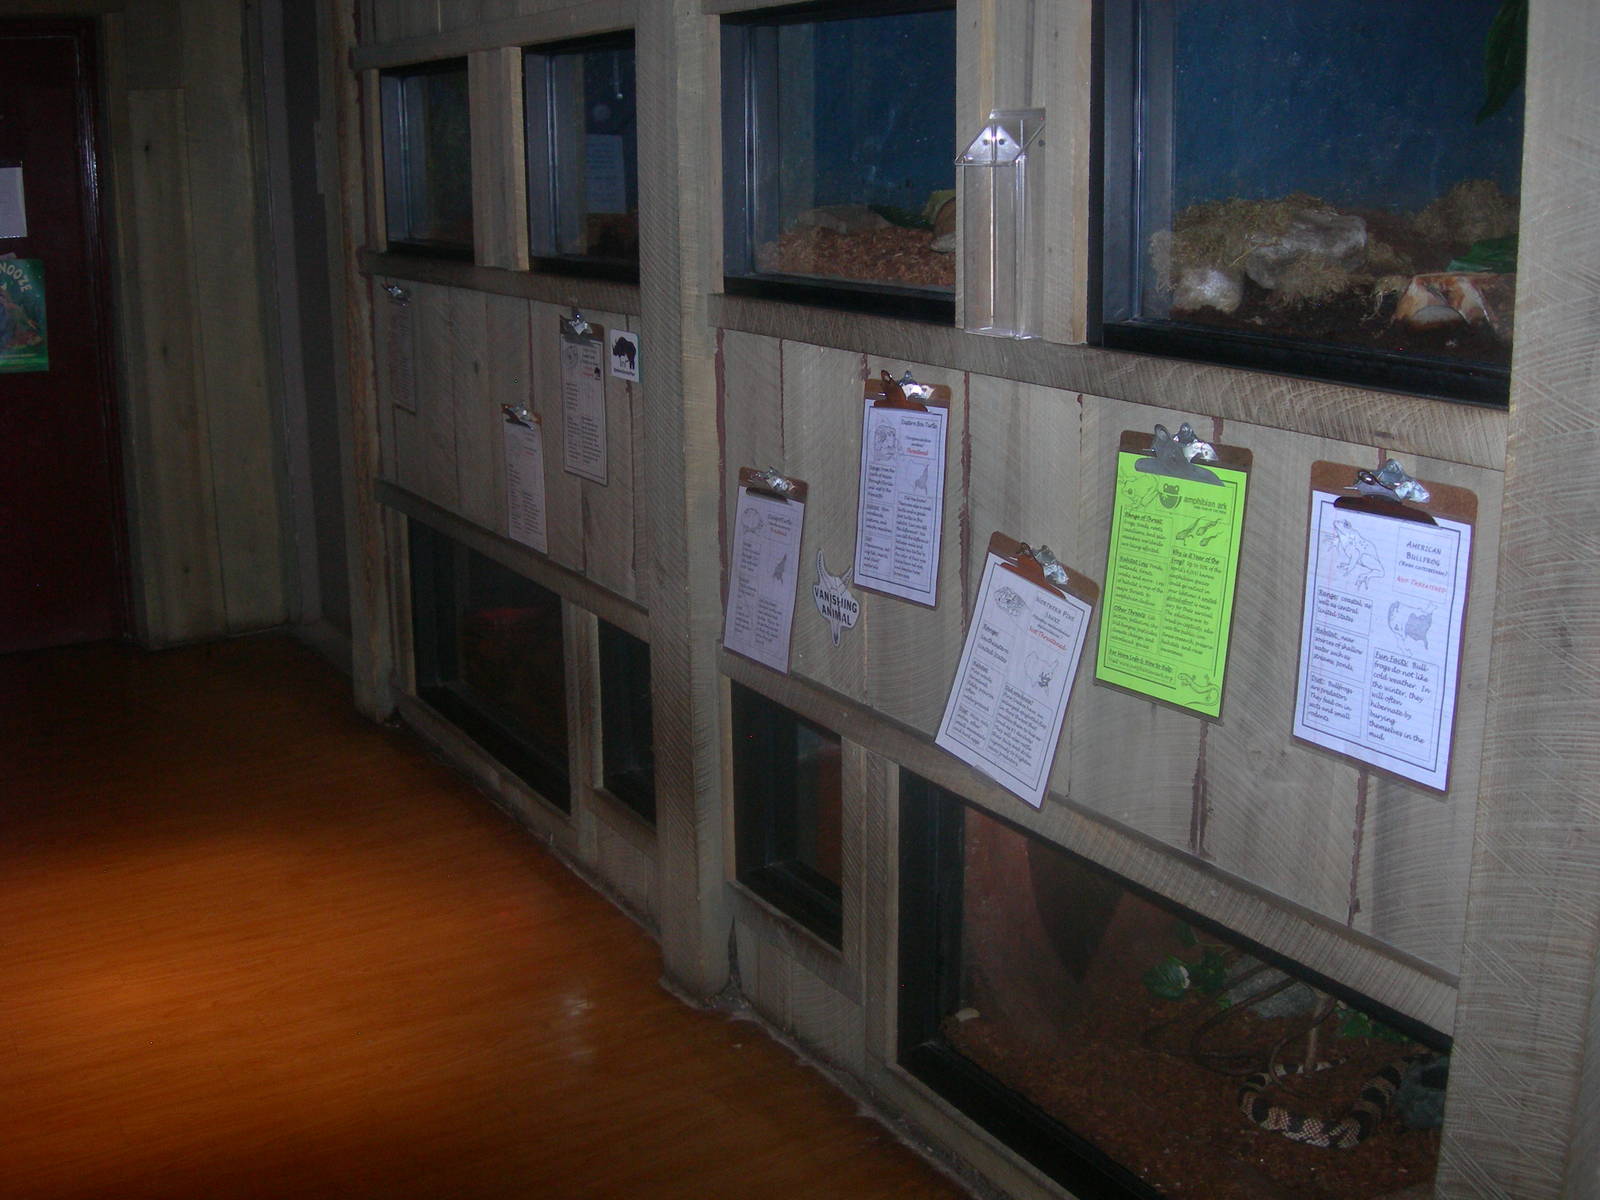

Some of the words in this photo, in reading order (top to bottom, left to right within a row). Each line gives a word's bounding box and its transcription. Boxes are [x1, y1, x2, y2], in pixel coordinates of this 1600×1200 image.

[1183, 493, 1215, 508] amphibian
[1406, 540, 1441, 555] AMERICAN
[1406, 551, 1440, 567] BULLFROG
[815, 587, 858, 614] VANISHING
[1318, 598, 1329, 606] well
[822, 604, 851, 626] ANIMAL
[1317, 607, 1336, 617] United
[1337, 613, 1353, 622] States
[1314, 637, 1334, 646] sources
[1314, 644, 1329, 653] water
[1330, 649, 1342, 657] such
[1375, 651, 1388, 661] Fun
[1373, 670, 1387, 680] cold
[1374, 659, 1390, 673] frogs
[1402, 669, 1413, 678] not
[1415, 672, 1428, 682] like
[1310, 691, 1322, 701] They
[1322, 696, 1334, 705] feed
[1371, 689, 1383, 699] will
[1372, 680, 1383, 689] the
[1408, 691, 1424, 704] they
[1322, 705, 1333, 714] and
[1334, 709, 1350, 720] small
[1370, 699, 1402, 716] hibernate
[1369, 710, 1395, 726] burying
[1369, 719, 1402, 737] themselves
[1412, 734, 1424, 744] the
